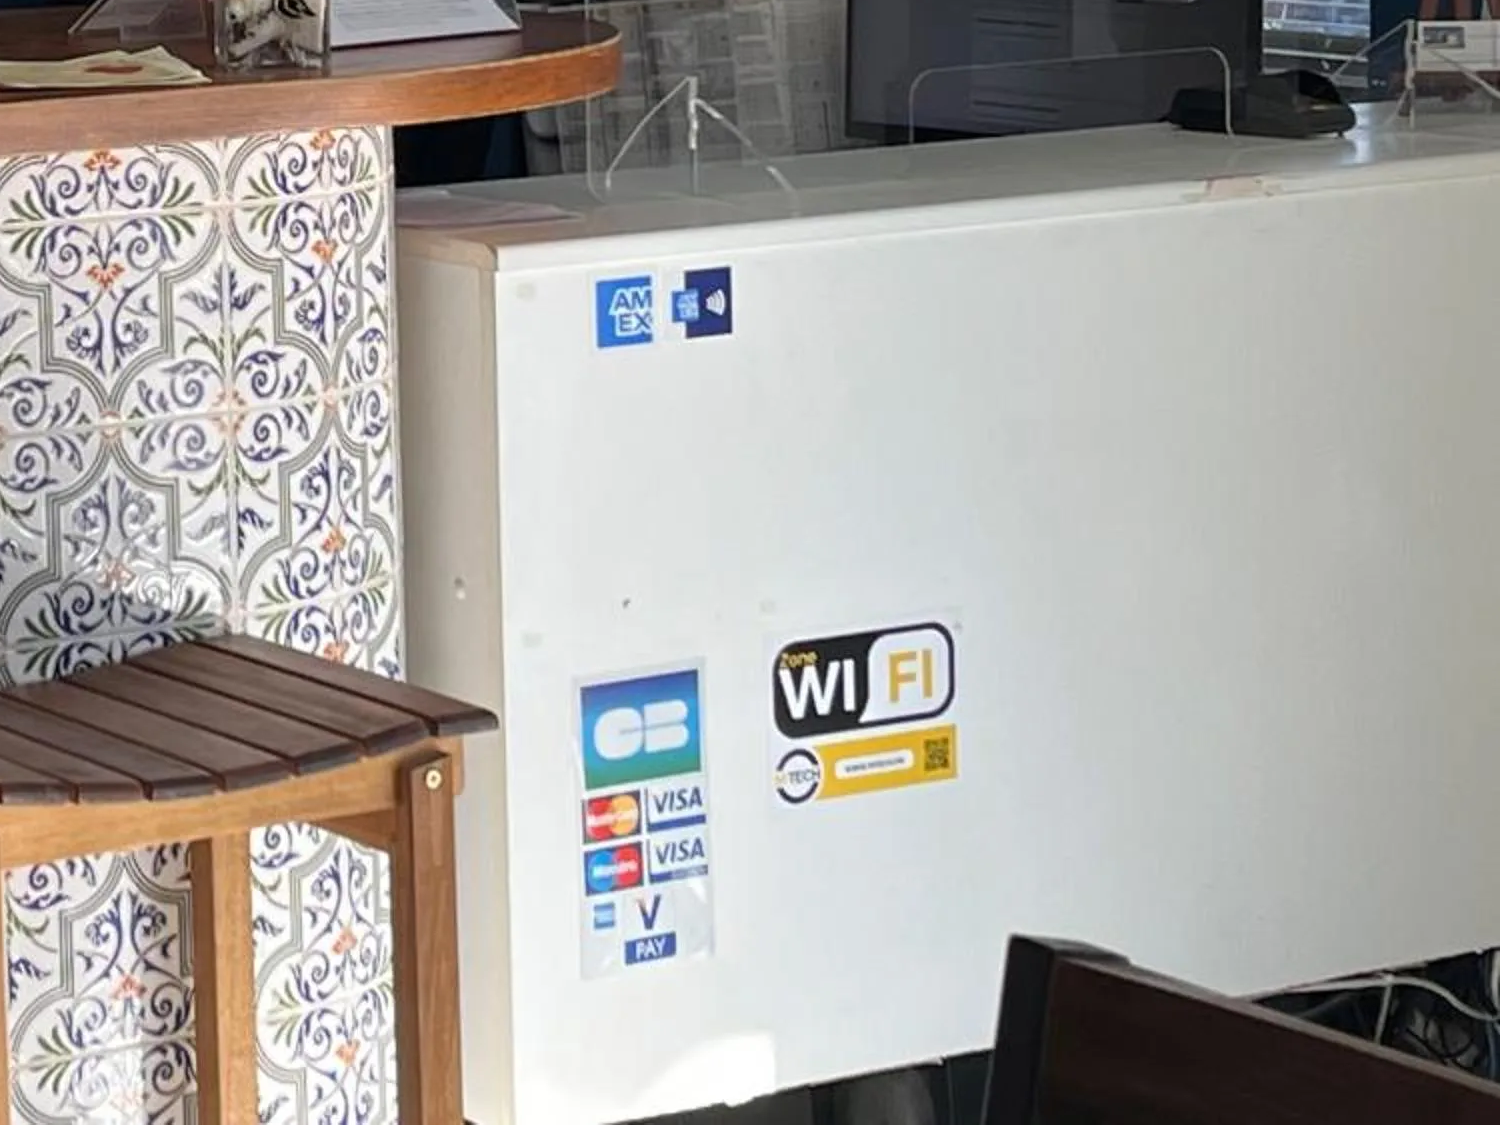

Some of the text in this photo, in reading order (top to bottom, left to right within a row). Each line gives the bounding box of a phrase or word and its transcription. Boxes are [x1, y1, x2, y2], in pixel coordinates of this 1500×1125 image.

[610, 287, 652, 313] AM
[617, 312, 652, 335] EX
[778, 648, 934, 721] WI FI
[593, 699, 690, 761] CB
[652, 785, 704, 815] VISA
[655, 836, 706, 865] VISA
[635, 938, 667, 960] PAY
